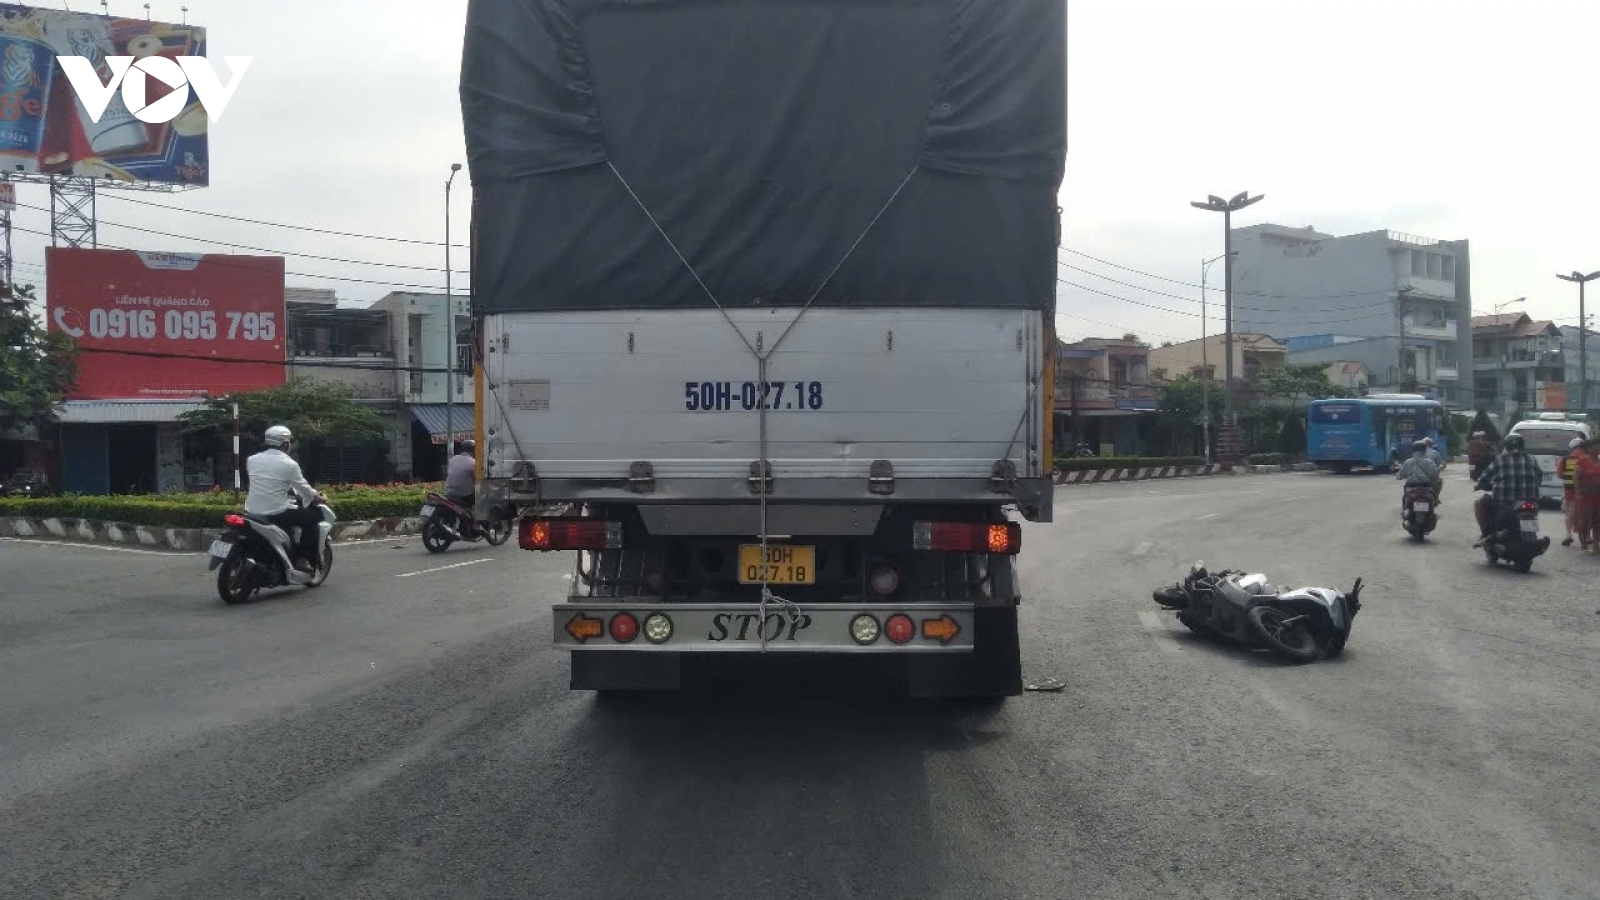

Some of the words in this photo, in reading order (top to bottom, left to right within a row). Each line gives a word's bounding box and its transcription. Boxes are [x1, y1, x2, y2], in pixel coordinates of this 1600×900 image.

[89, 309, 157, 339] 0916
[164, 310, 217, 340] 095
[226, 312, 275, 341] 795
[685, 381, 823, 411] 50H-027.18
[760, 547, 793, 563] 50H
[747, 565, 806, 582] 027.18
[707, 612, 812, 642] STOP
